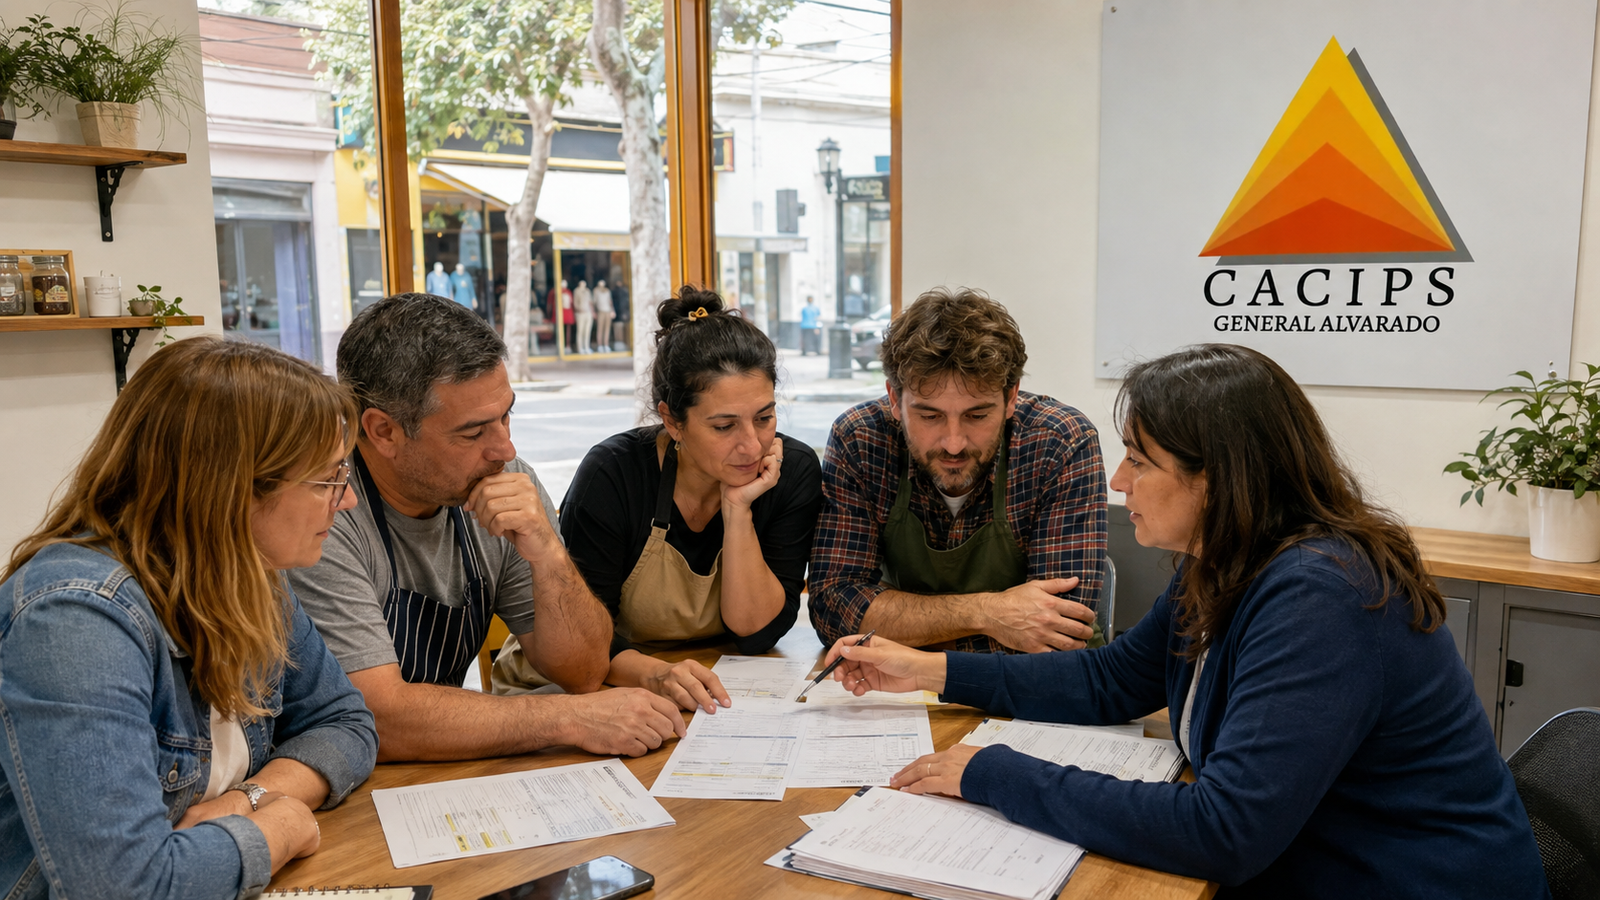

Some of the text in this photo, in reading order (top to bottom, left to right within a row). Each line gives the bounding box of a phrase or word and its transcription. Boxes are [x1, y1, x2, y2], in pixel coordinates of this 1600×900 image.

[1203, 267, 1455, 307] CACIPS
[1213, 315, 1441, 333] GENERAL ALVARADO
